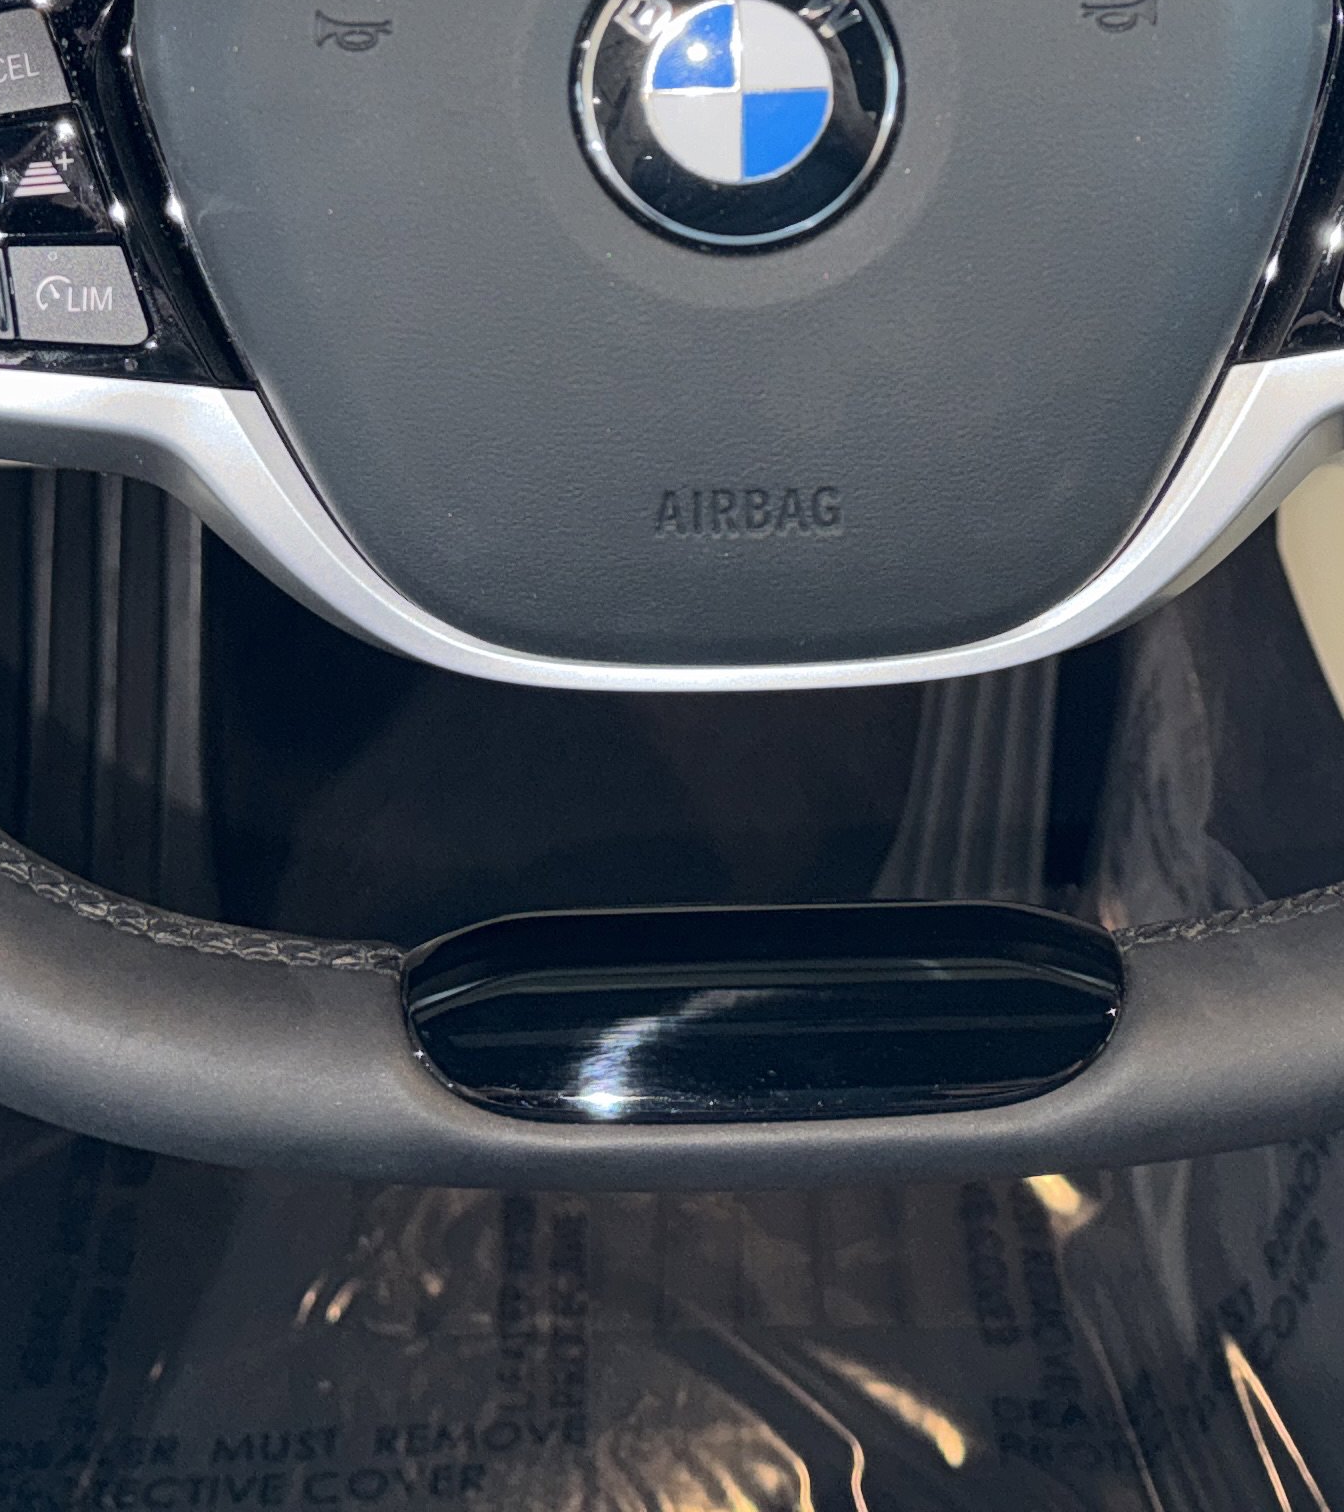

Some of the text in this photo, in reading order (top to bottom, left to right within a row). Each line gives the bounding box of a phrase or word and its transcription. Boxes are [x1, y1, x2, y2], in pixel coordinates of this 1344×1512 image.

[67, 285, 115, 313] LIM
[655, 485, 846, 539] AIRBAG
[212, 1423, 340, 1464] MUST
[373, 1408, 590, 1458] REMOVE
[304, 1458, 488, 1506] COVER
